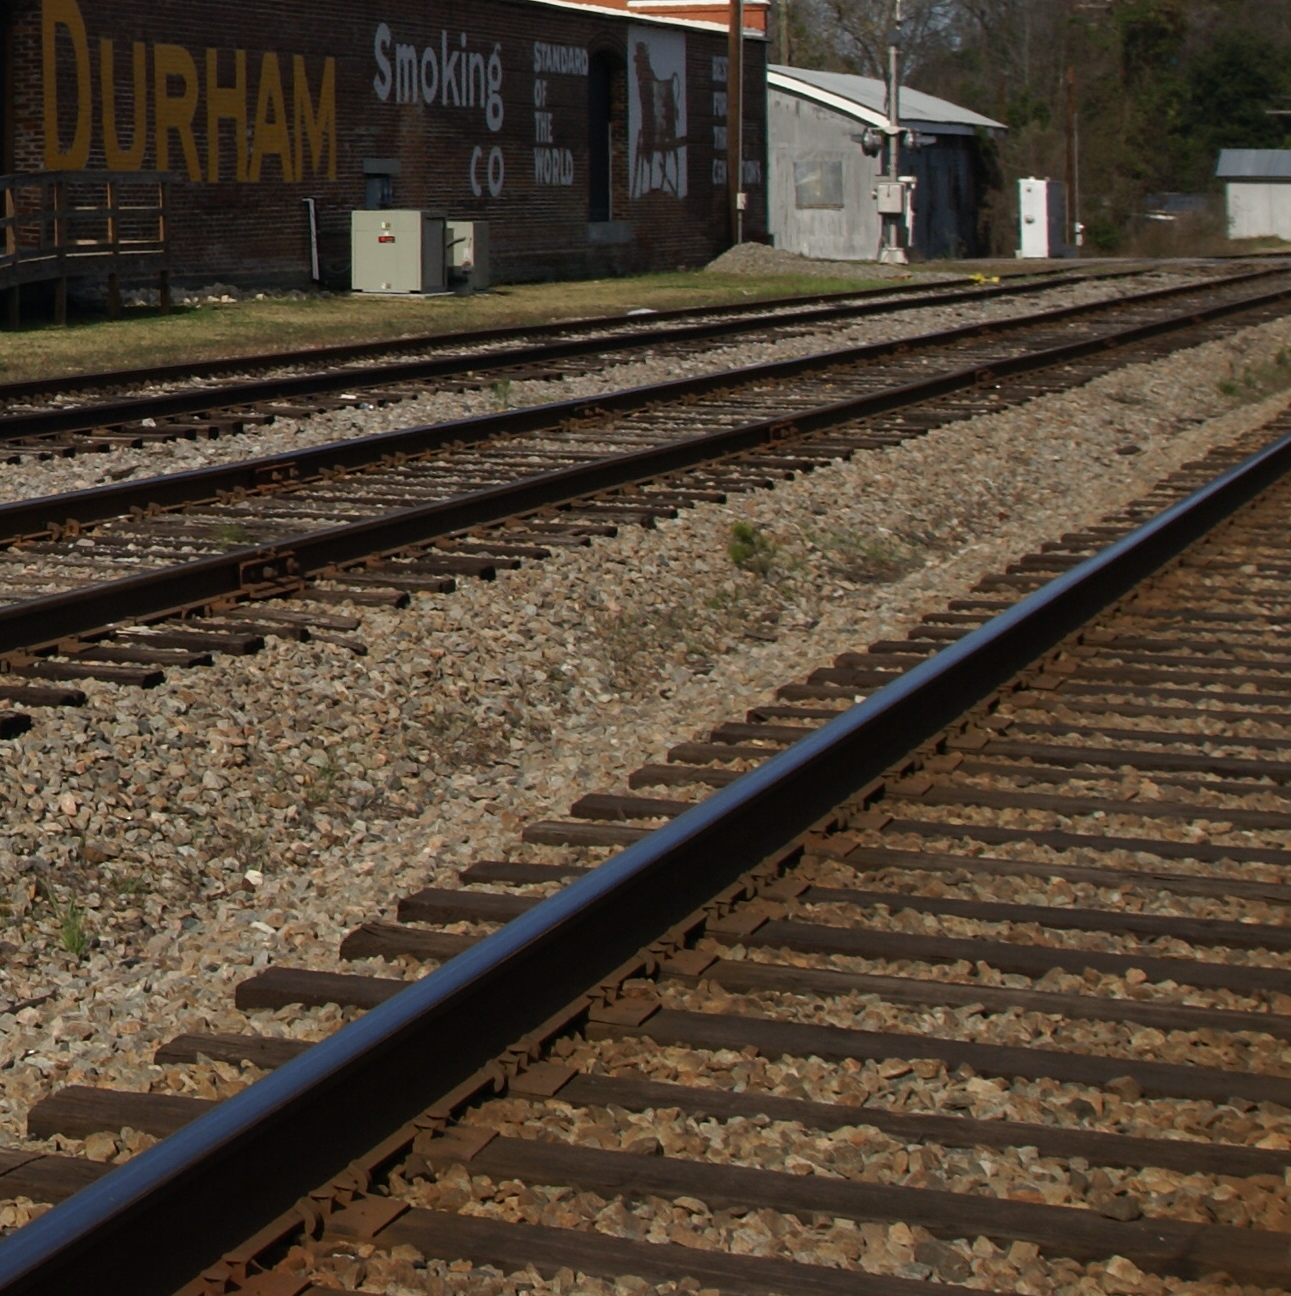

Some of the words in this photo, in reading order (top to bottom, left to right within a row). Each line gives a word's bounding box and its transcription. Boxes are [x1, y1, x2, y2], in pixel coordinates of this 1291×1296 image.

[373, 22, 503, 132] Smoking
[533, 41, 589, 76] STANDARD
[533, 79, 547, 107] OF
[534, 111, 553, 143] THE
[470, 146, 504, 198] CO
[534, 147, 574, 186] WORLD
